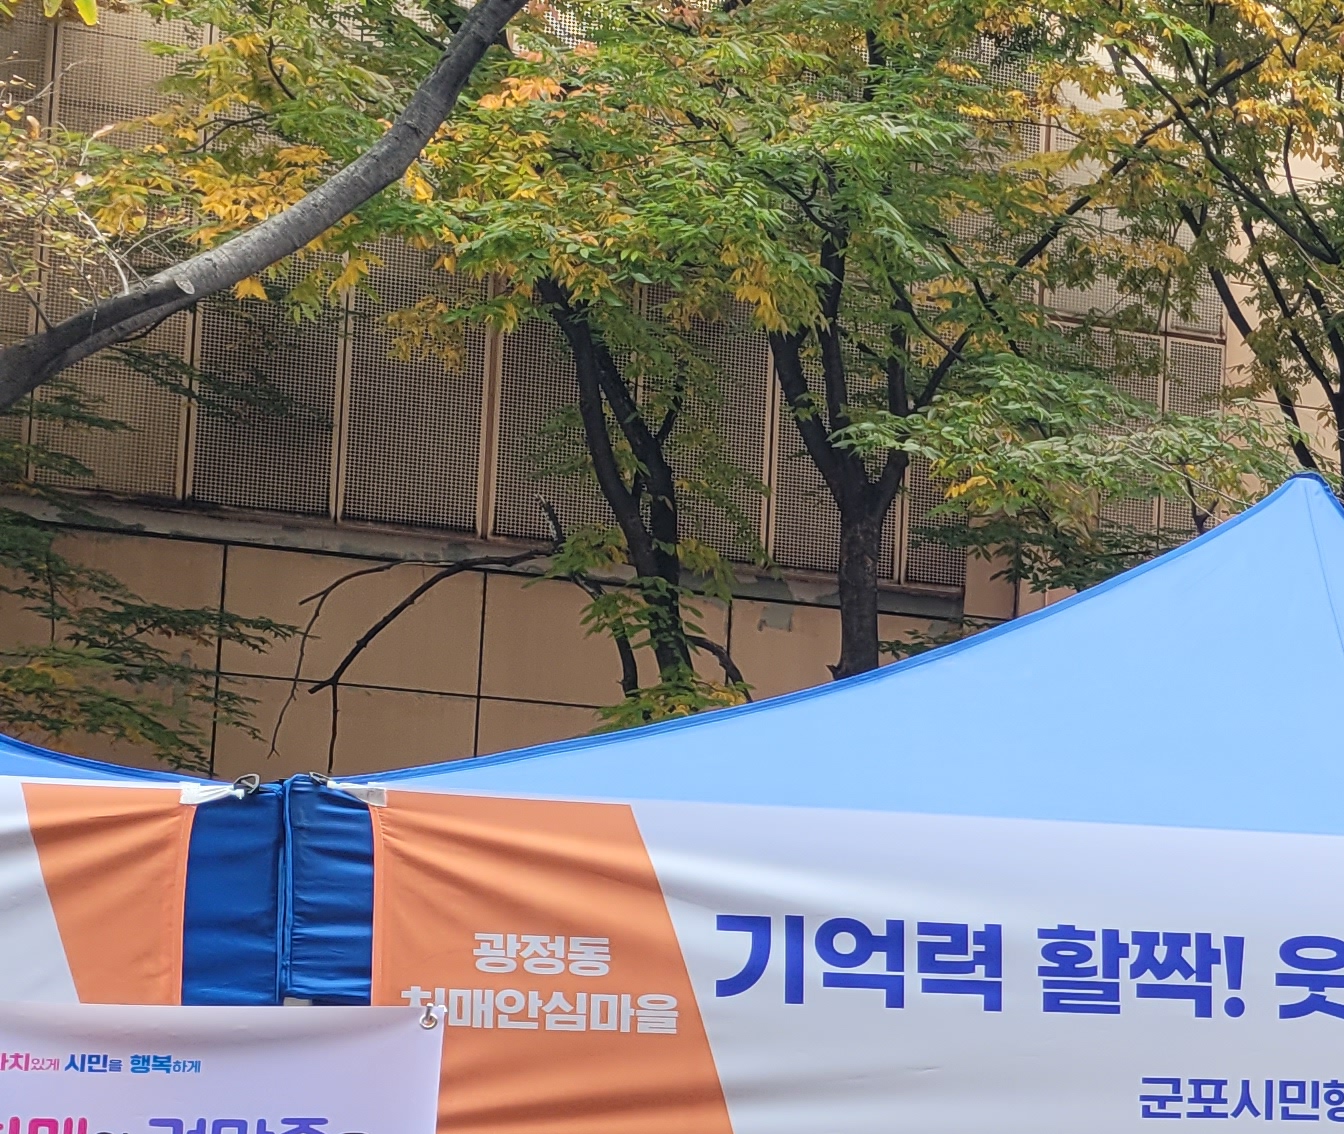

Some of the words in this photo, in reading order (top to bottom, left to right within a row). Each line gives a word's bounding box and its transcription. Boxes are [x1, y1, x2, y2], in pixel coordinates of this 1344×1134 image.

[472, 931, 612, 977] 광정동
[715, 913, 1003, 1012] 기억력
[1036, 923, 1246, 1019] 활짝!
[64, 1053, 124, 1074] 시민을
[130, 1053, 202, 1075] 행복하게
